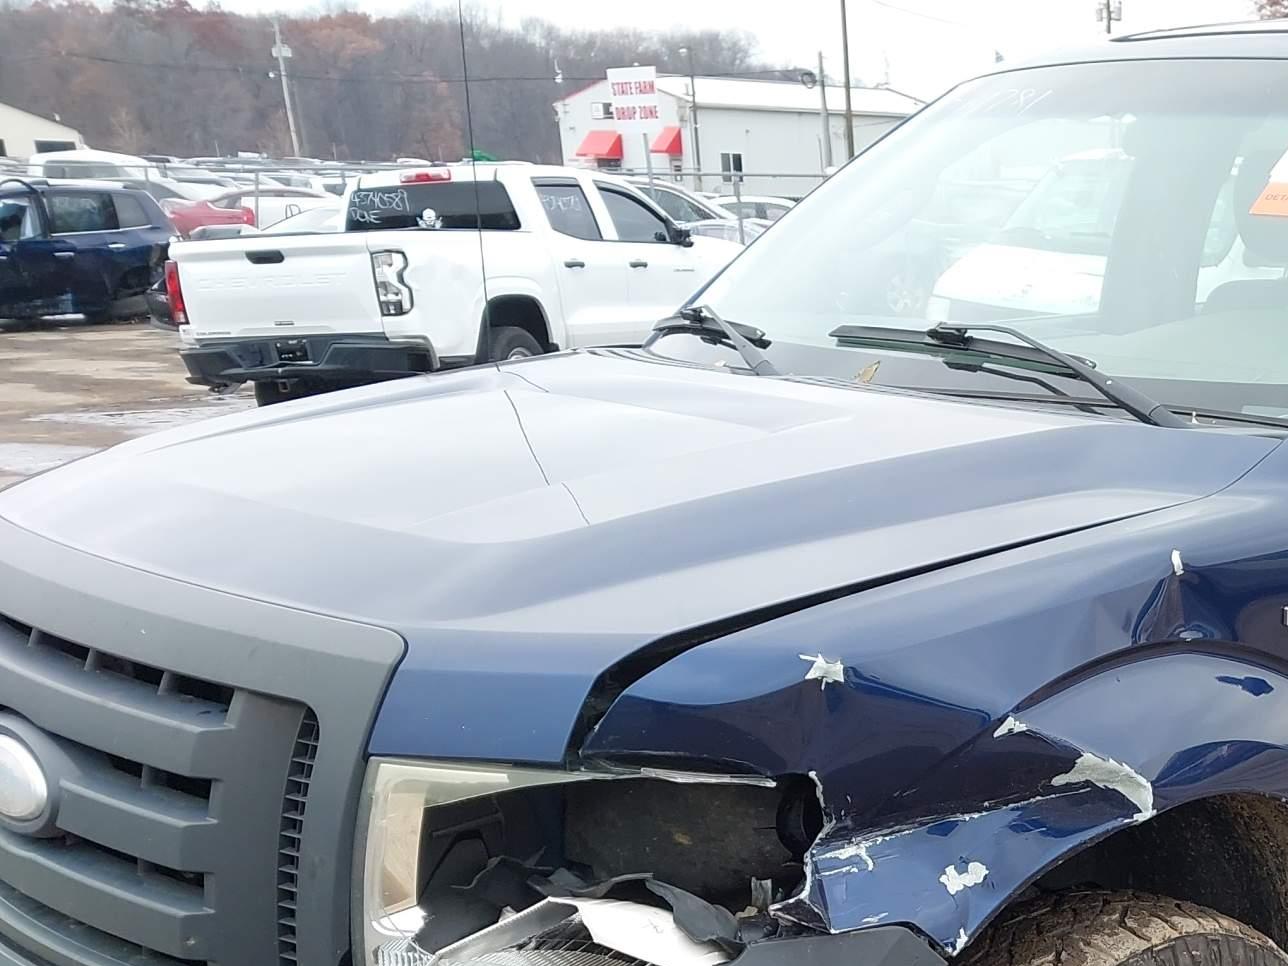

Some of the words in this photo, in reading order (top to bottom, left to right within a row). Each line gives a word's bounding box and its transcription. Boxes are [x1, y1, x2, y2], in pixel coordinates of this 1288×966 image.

[611, 82, 633, 96] STATE
[634, 80, 656, 94] FARM
[615, 106, 637, 120] DROP
[638, 105, 659, 119] ZONE
